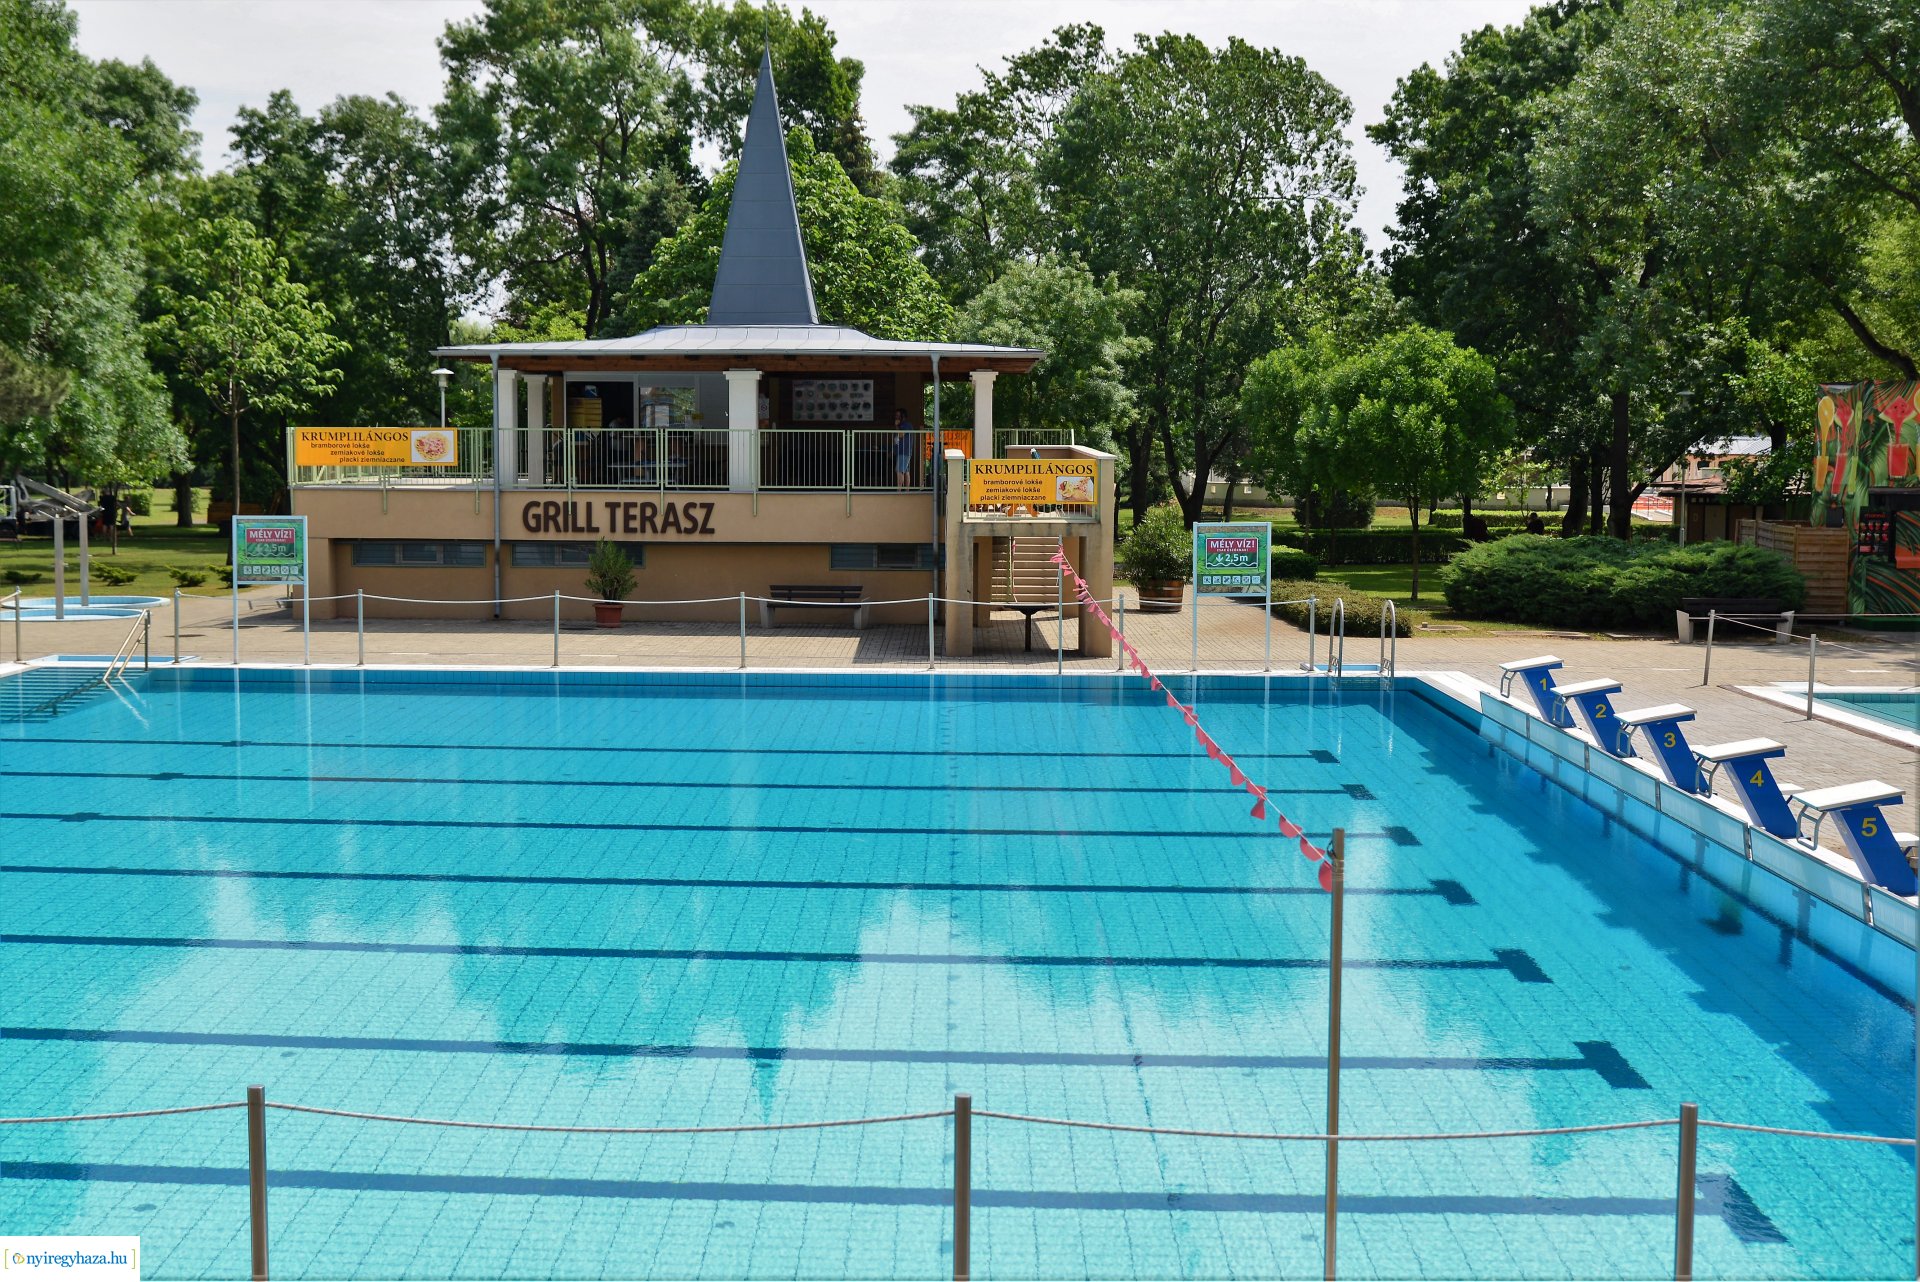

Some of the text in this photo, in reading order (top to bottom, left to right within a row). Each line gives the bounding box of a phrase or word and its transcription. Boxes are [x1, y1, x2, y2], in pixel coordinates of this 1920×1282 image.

[301, 430, 409, 442] KRUMPLILÁNGOS
[339, 456, 360, 464] placki
[975, 463, 1093, 475] KRUMPLILÁNGOS
[980, 494, 1001, 502] placki
[522, 500, 716, 534] GRILL TERASZ
[249, 529, 292, 539] MÉLY VÍZ!
[1210, 538, 1255, 549] MÉLY VÍZ!
[1539, 677, 1549, 691] 1
[1595, 704, 1607, 718] 2
[1663, 732, 1677, 748] 3
[1749, 769, 1764, 788] 4
[1860, 817, 1878, 837] 5
